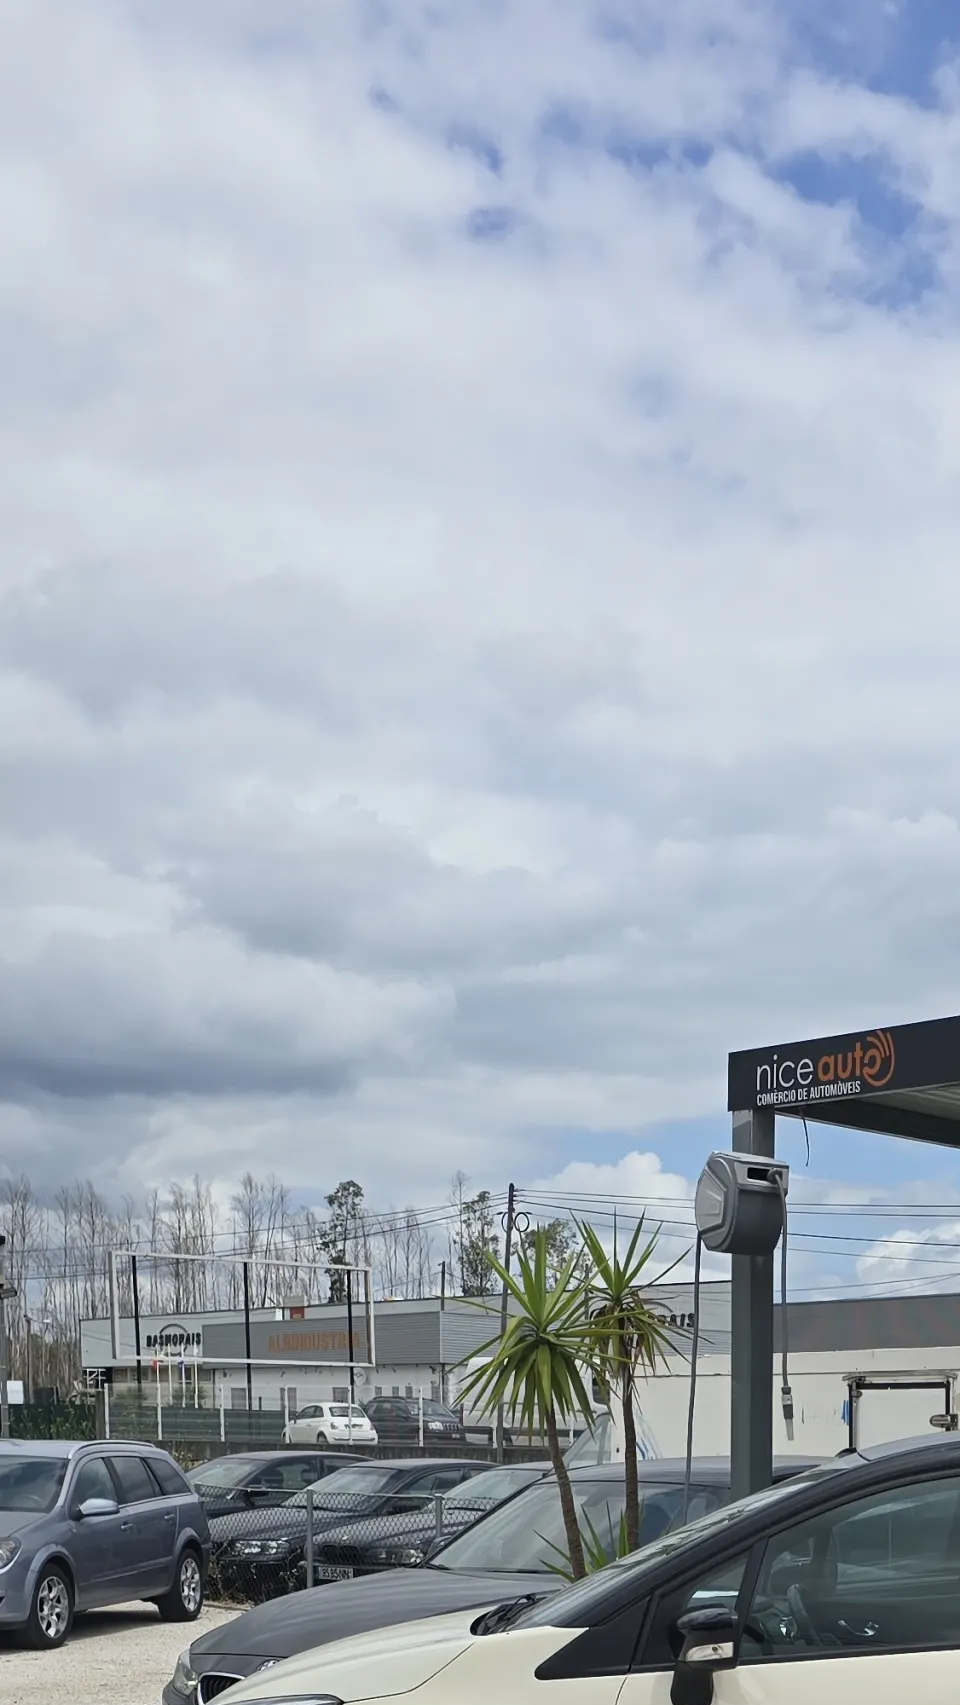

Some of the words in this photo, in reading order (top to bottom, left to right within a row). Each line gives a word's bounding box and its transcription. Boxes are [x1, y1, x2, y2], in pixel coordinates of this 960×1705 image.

[756, 1054, 814, 1091] nice
[817, 1038, 895, 1086] auto
[797, 1088, 808, 1101] DE
